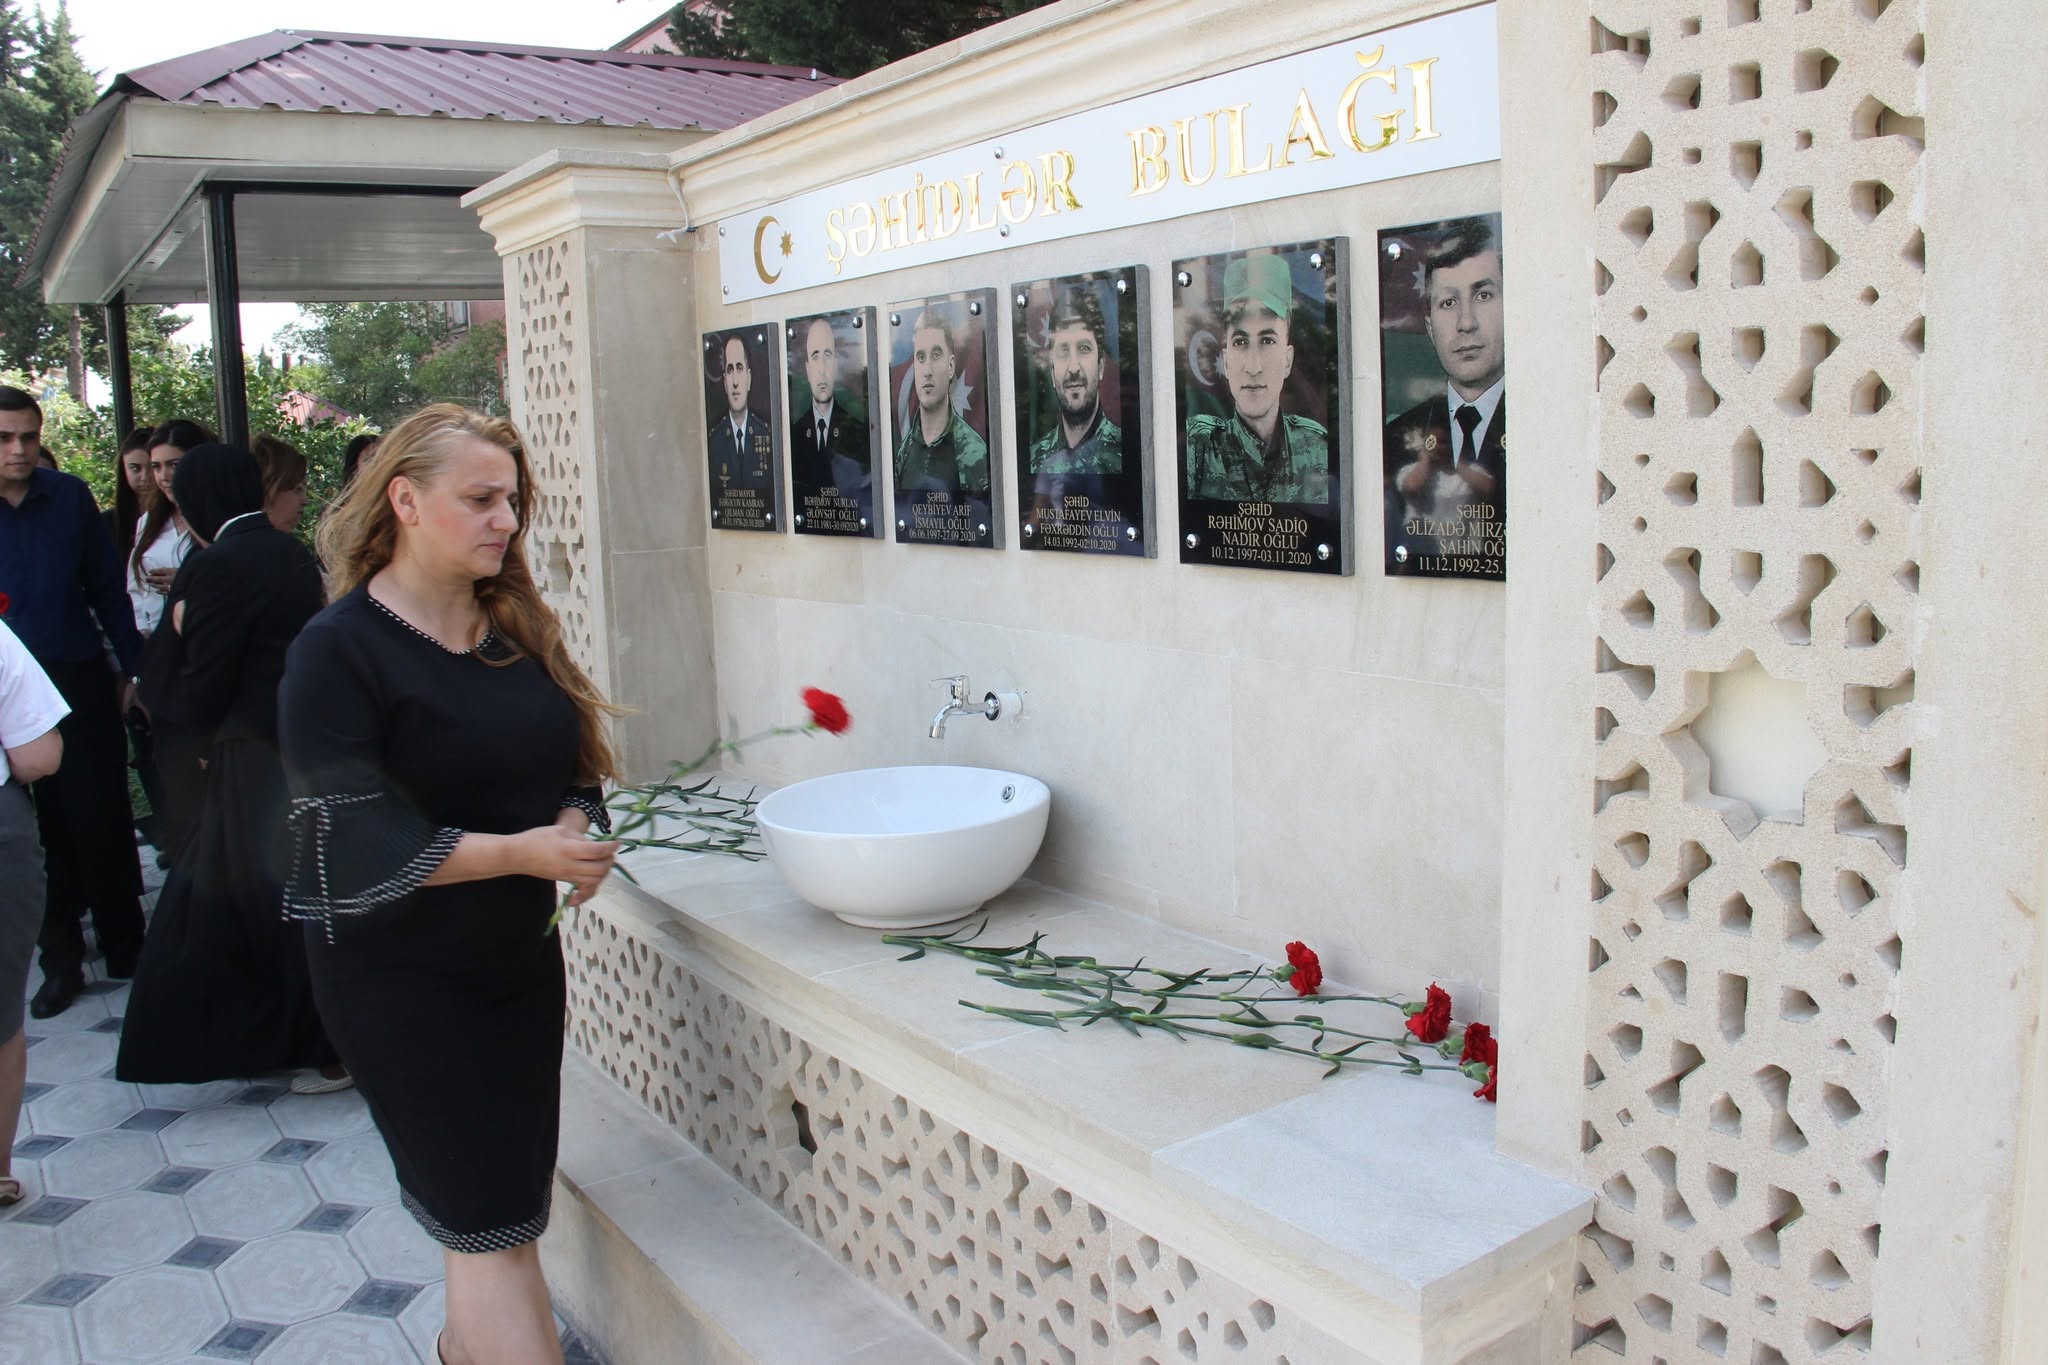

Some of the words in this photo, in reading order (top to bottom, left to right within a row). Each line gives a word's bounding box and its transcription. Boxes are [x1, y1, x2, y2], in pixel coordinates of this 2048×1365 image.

[825, 150, 1083, 276] ŞƏHİDLƏR
[1125, 44, 1442, 197] BULAĞI
[739, 489, 756, 498] MAYOR
[820, 486, 839, 497] ŞƏHİD
[927, 490, 949, 503] ŞƏHİD
[742, 499, 764, 508] KAMRAN
[804, 496, 831, 507] RƏHİMOV
[833, 498, 859, 508] NURLAN
[1063, 494, 1090, 509] ŞƏHİD
[746, 508, 760, 518] OĞLU
[839, 508, 858, 521] OĞLU
[912, 503, 952, 516] QEYBİYEV
[953, 502, 972, 517] ARİF
[1036, 508, 1093, 522] MUSTAFAYEV
[1094, 508, 1121, 523] ELVİN
[1238, 501, 1273, 518] ŞƏHİD
[1456, 502, 1495, 521] ŞƏHİD
[948, 517, 971, 530] OĞLU
[1040, 521, 1091, 537] FƏXRƏDDİN
[1092, 523, 1119, 538] OĞLU
[1208, 514, 1266, 532] RƏHİMOV
[1268, 516, 1309, 537] SADİQ
[1406, 518, 1466, 537] ƏLİZADƏ
[909, 529, 976, 542] 06.06.1997-27.09.2020
[1222, 530, 1261, 548] NADİR
[1263, 530, 1299, 550] OĞLU
[1044, 536, 1117, 551] 14.03.1992-02.10.2020
[1440, 537, 1481, 558] ŞAHİN
[1211, 546, 1312, 566] 10.12.1997-03.11.2020
[1419, 556, 1503, 575] 11.12.1992-25.
